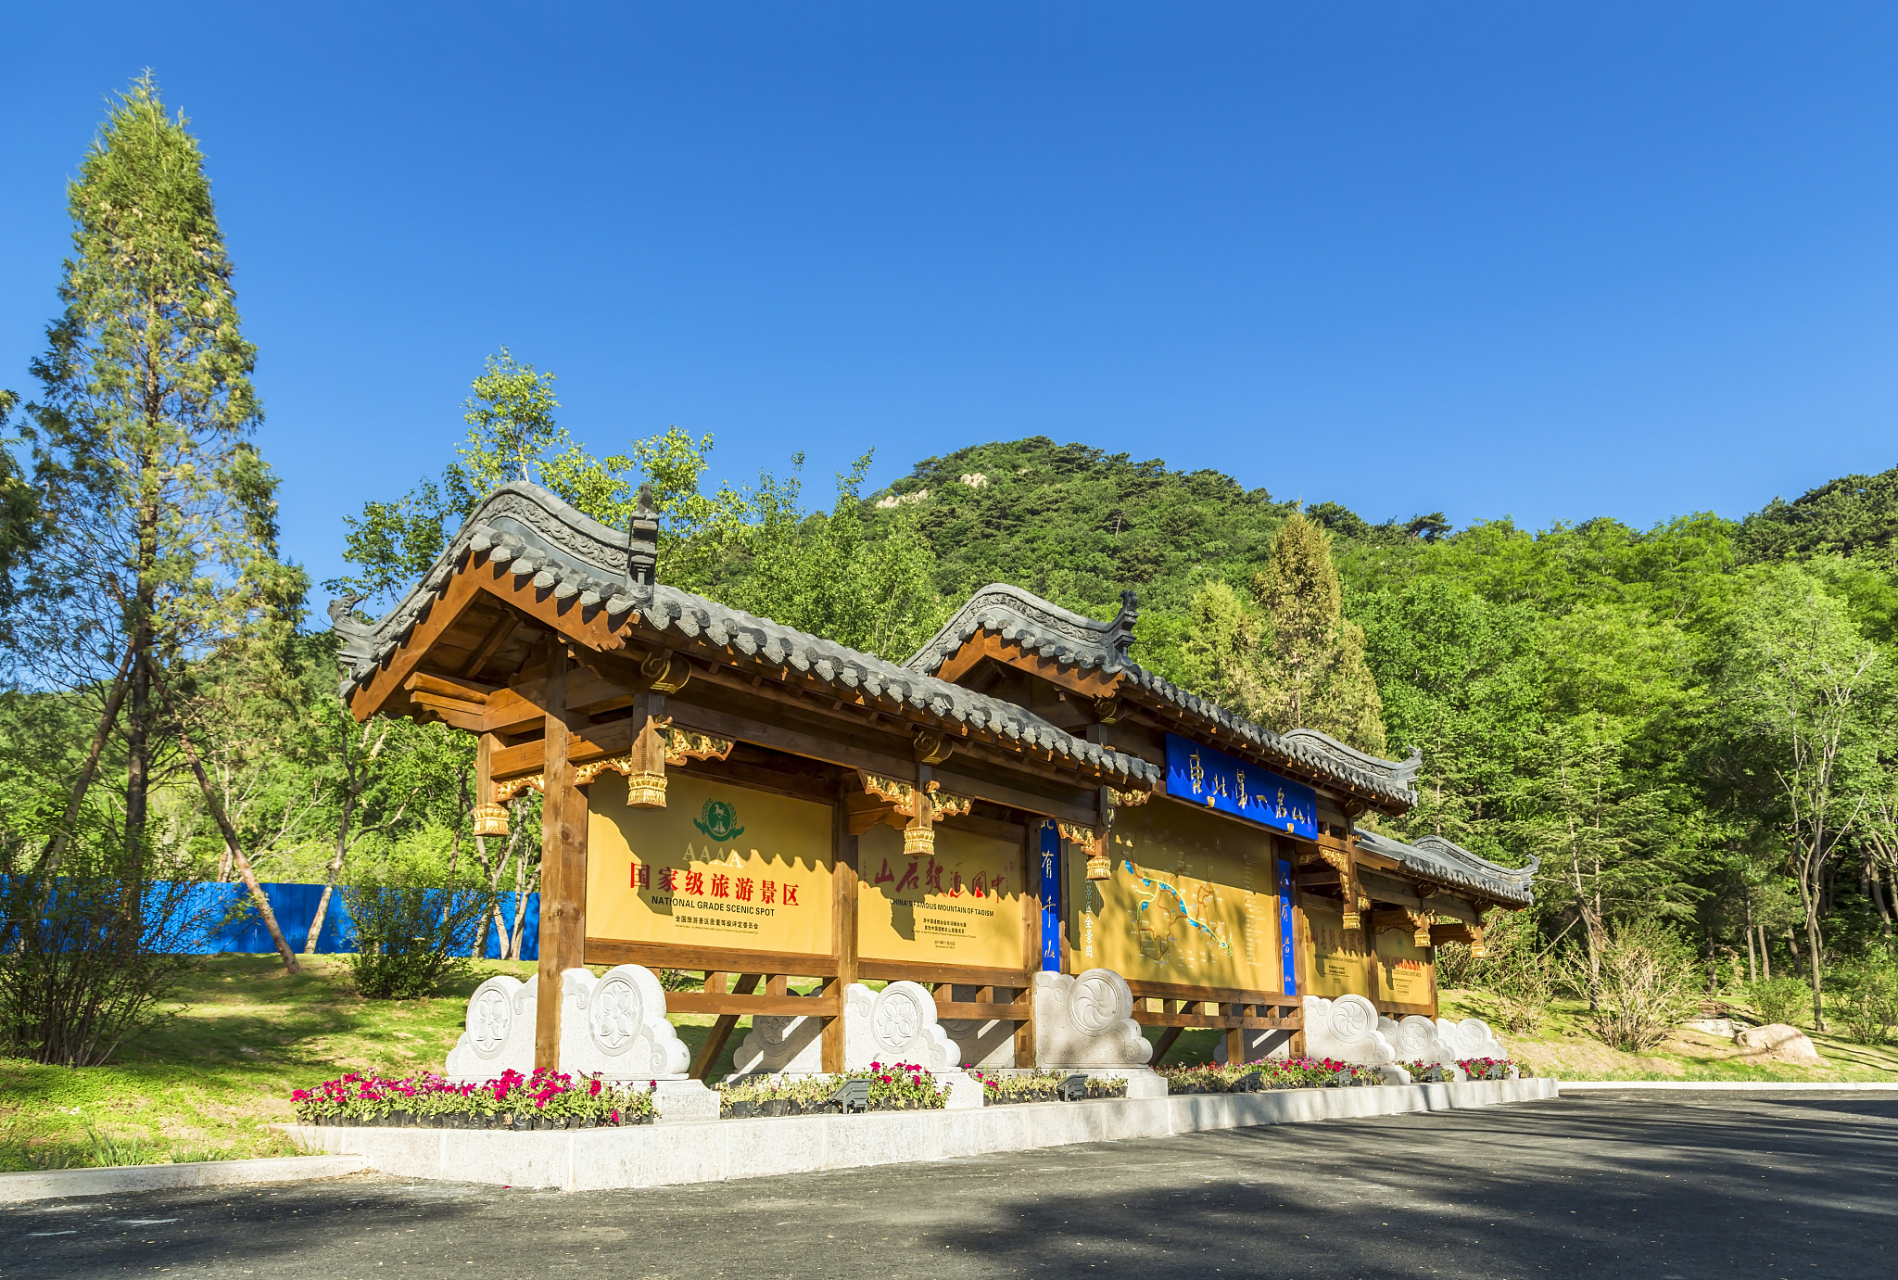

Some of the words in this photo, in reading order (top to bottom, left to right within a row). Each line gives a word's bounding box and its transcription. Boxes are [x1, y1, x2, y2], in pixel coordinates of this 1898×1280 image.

[682, 842, 744, 868] AAAA
[630, 862, 800, 907] 国家级旅游景区
[651, 896, 695, 908] NATIONAL
[697, 901, 724, 911] GRADE
[726, 904, 754, 915] SCENIC
[755, 907, 775, 917] SPOT
[937, 904, 966, 914] MOUNTAIN
